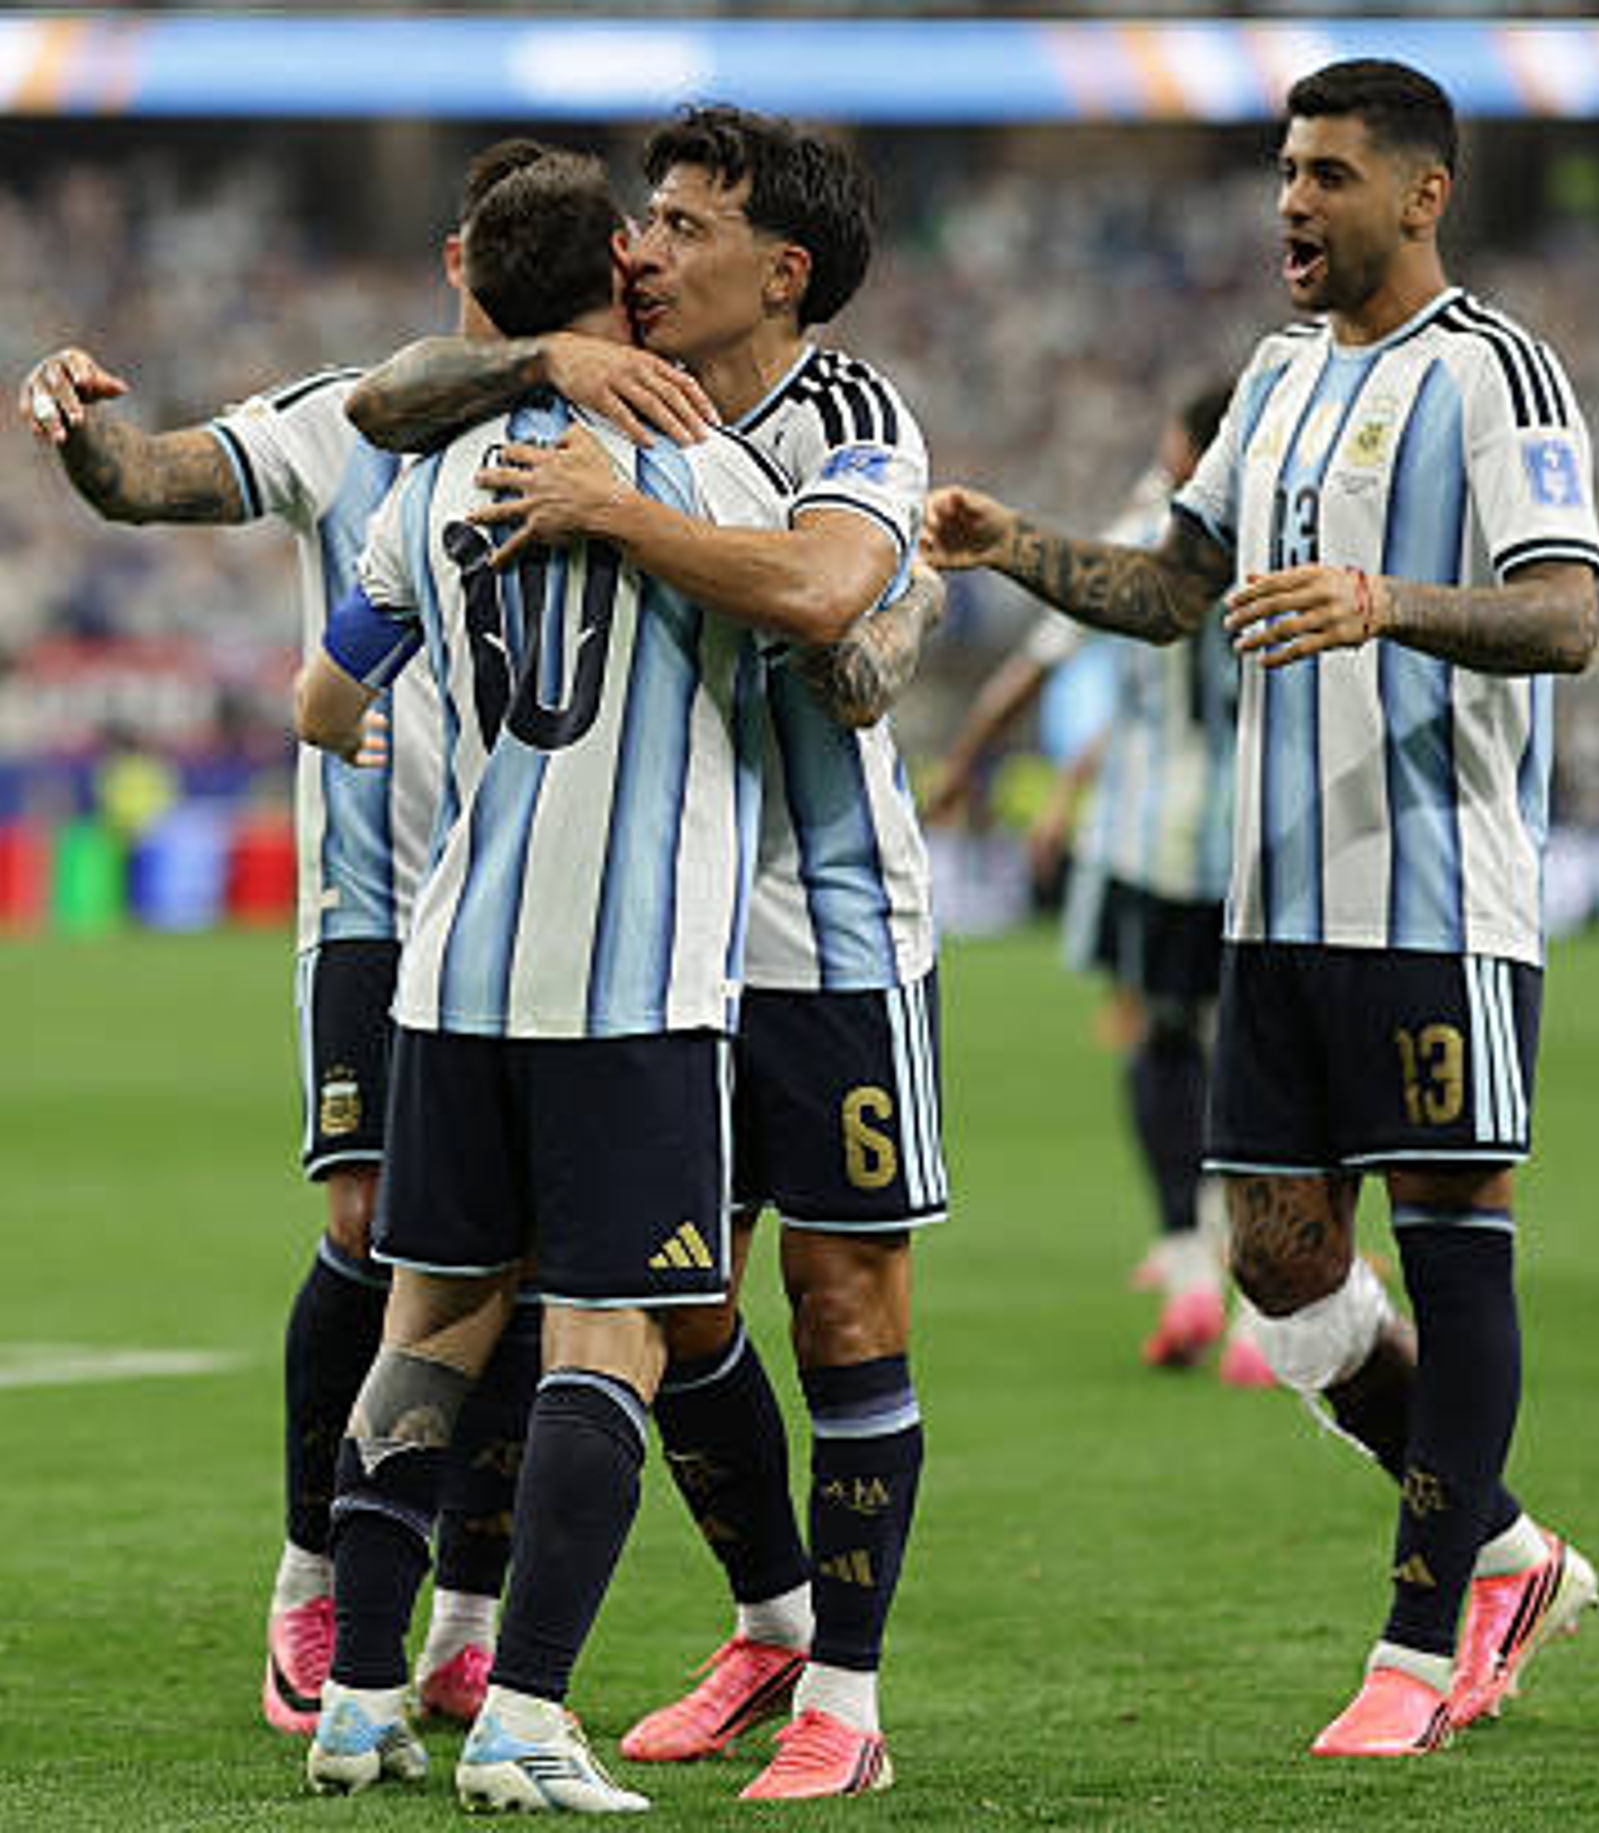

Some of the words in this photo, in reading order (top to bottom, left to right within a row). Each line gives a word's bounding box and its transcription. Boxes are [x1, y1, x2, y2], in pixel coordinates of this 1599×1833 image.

[1269, 484, 1321, 571] 13
[1395, 1024, 1464, 1124] 13
[842, 1085, 897, 1188] 6
